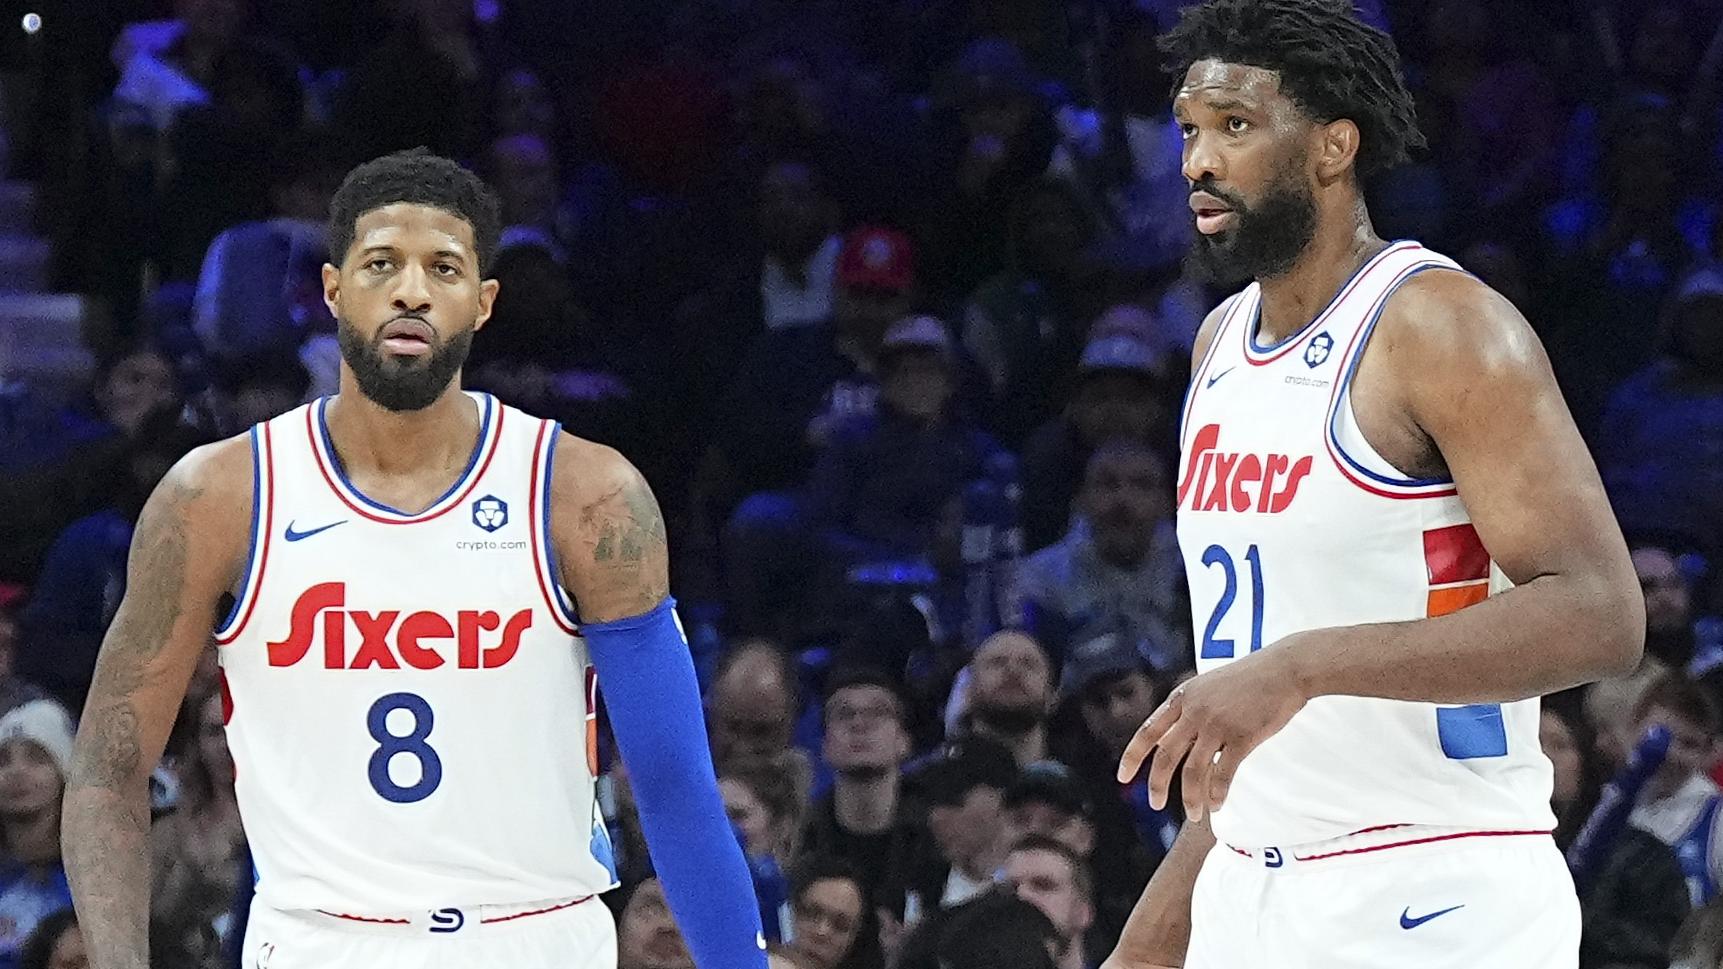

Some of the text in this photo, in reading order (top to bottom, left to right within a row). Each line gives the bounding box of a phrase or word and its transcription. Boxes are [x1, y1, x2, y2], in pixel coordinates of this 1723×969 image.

[1177, 423, 1313, 514] Sixers
[456, 540, 527, 551] crypto.com
[266, 581, 533, 671] Sixers
[1200, 543, 1265, 660] 21
[367, 692, 443, 804] 8
